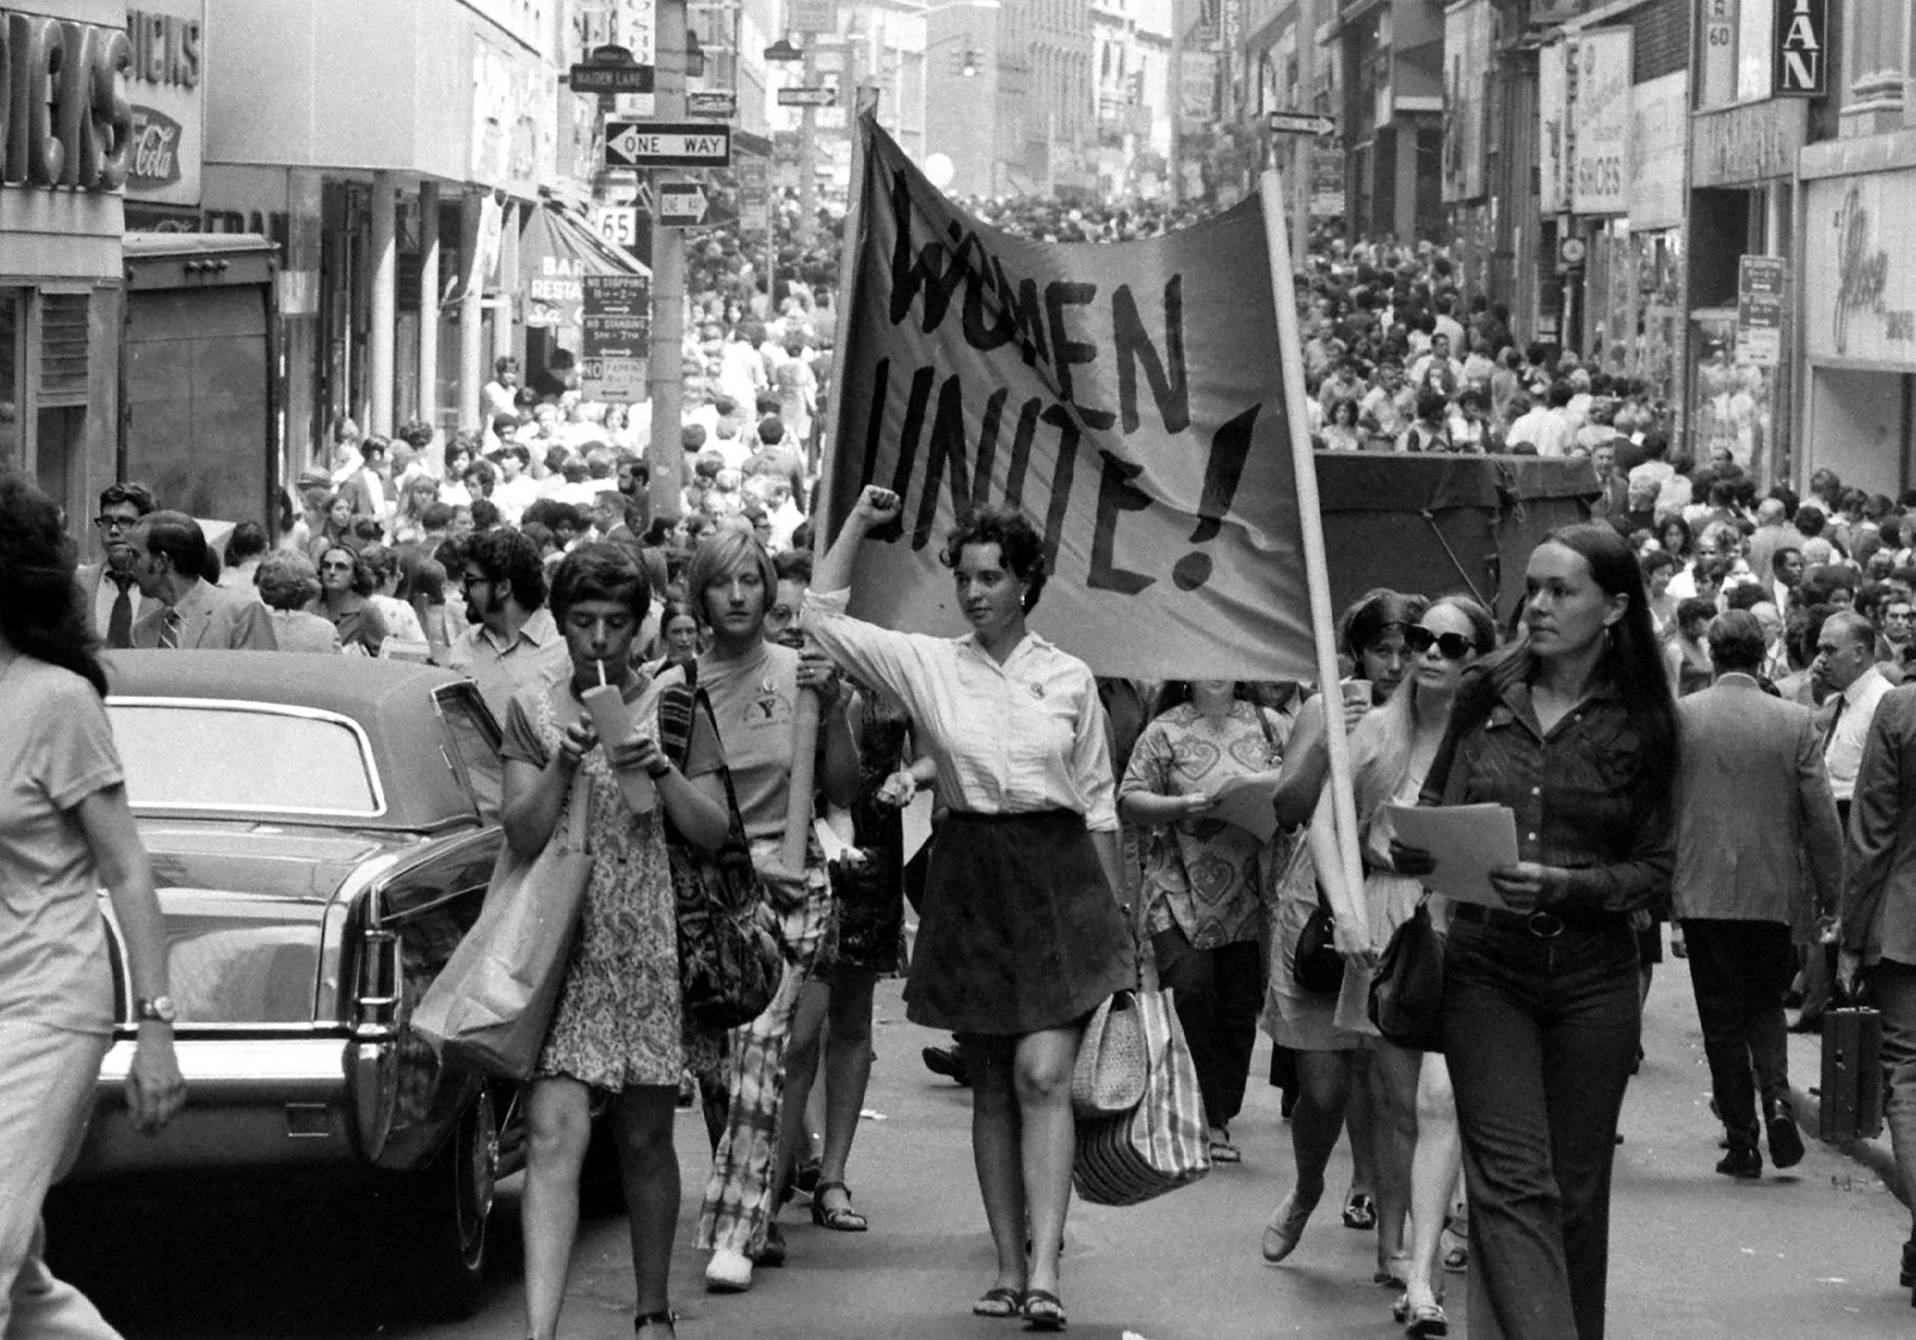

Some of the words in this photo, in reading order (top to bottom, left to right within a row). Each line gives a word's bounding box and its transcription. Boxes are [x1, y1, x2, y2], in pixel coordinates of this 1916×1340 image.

[1709, 27, 1729, 46] 60
[624, 137, 660, 153] ONE
[684, 137, 721, 153] WAY
[602, 213, 629, 242] 65
[543, 256, 584, 276] BAR
[587, 277, 600, 288] NO
[888, 170, 1191, 435] WOMEN
[586, 319, 600, 329] NO
[582, 361, 603, 379] NO
